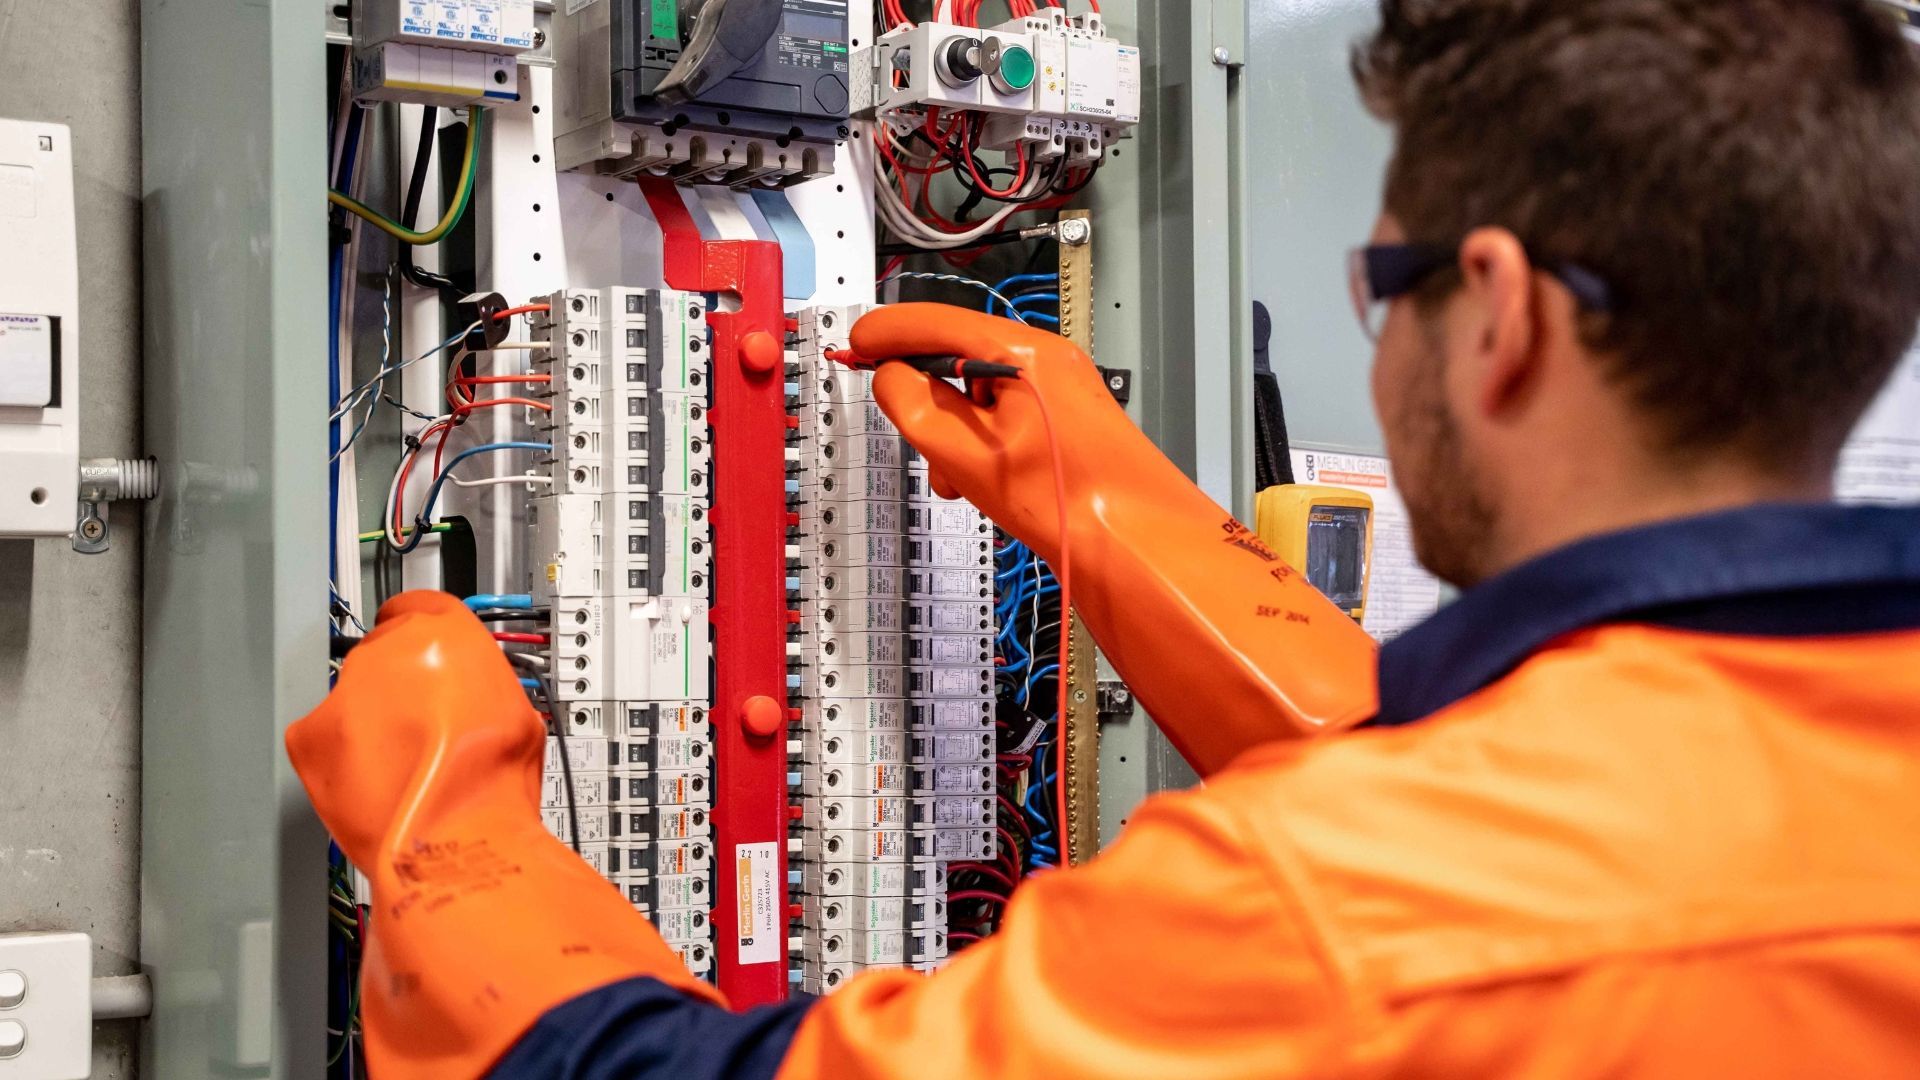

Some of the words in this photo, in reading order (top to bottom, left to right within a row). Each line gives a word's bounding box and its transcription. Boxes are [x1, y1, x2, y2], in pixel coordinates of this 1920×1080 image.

[404, 25, 431, 34] ERICO
[437, 28, 464, 38] ERICO
[470, 32, 497, 42] ERICO
[503, 37, 530, 46] ERICO
[493, 57, 504, 65] PE
[866, 404, 874, 432] Schneider
[866, 437, 874, 465] Schneider
[1317, 456, 1355, 472] MERLIN
[1357, 458, 1386, 474] GERIN
[866, 470, 874, 498] Schneider
[866, 503, 874, 531] Schneider
[867, 536, 875, 564] Schneider
[867, 568, 875, 597] Schneider
[867, 601, 875, 630] Schneider
[1256, 605, 1281, 617] SEP
[867, 635, 875, 663] Schneider
[867, 667, 876, 696] Schneider
[869, 702, 877, 730] Schneider
[683, 737, 691, 766] Schneider
[870, 734, 878, 763] Schneider
[683, 876, 691, 906] Schneider
[741, 874, 750, 903] Gerin
[872, 866, 880, 895] Schneider
[684, 909, 692, 939] Schneider
[742, 904, 751, 936] Merlin
[871, 900, 879, 929] Schneider
